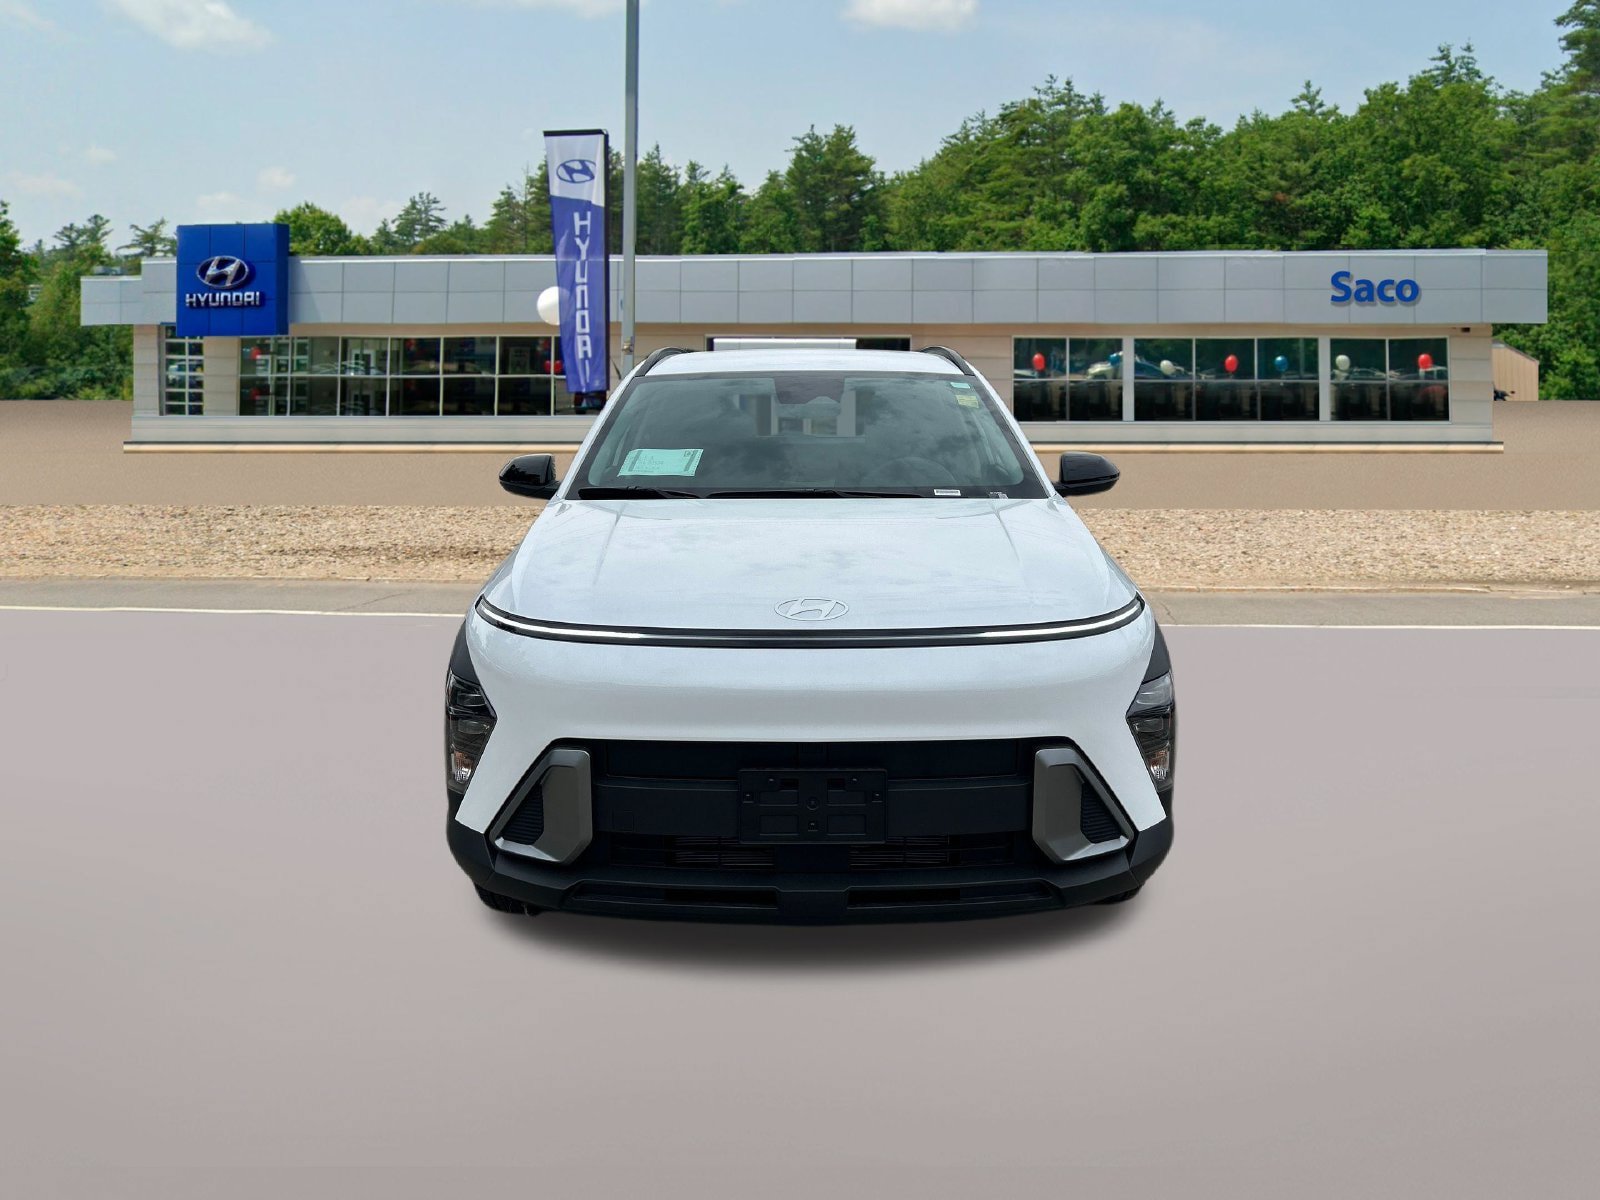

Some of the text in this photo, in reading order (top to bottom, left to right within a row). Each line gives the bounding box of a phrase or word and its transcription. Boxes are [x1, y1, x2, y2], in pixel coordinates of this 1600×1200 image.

[185, 291, 260, 307] HYUNDAI
[573, 211, 592, 383] HYUNDAI
[1330, 270, 1419, 302] Saco
